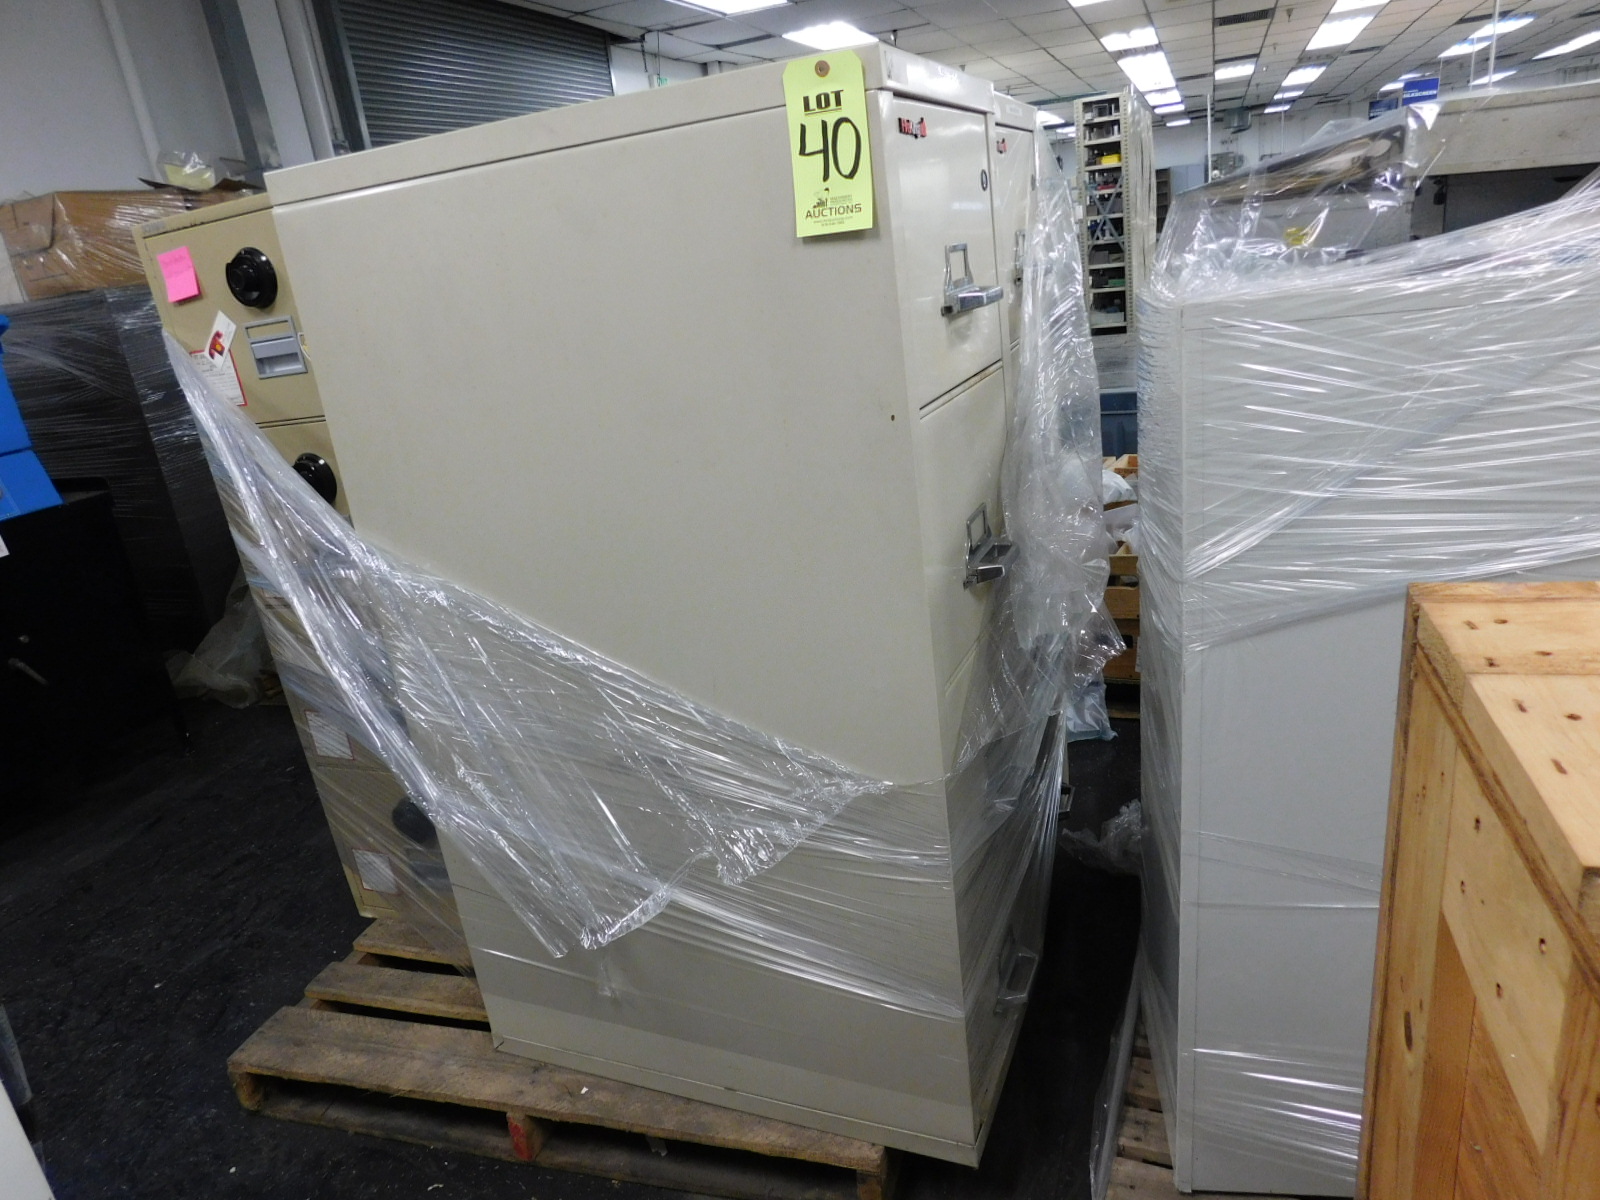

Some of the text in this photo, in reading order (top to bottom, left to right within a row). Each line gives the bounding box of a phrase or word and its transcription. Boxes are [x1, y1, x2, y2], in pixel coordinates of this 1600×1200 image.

[803, 90, 844, 112] LOT
[799, 117, 861, 182] 40
[805, 203, 862, 219] AUCTIONS
